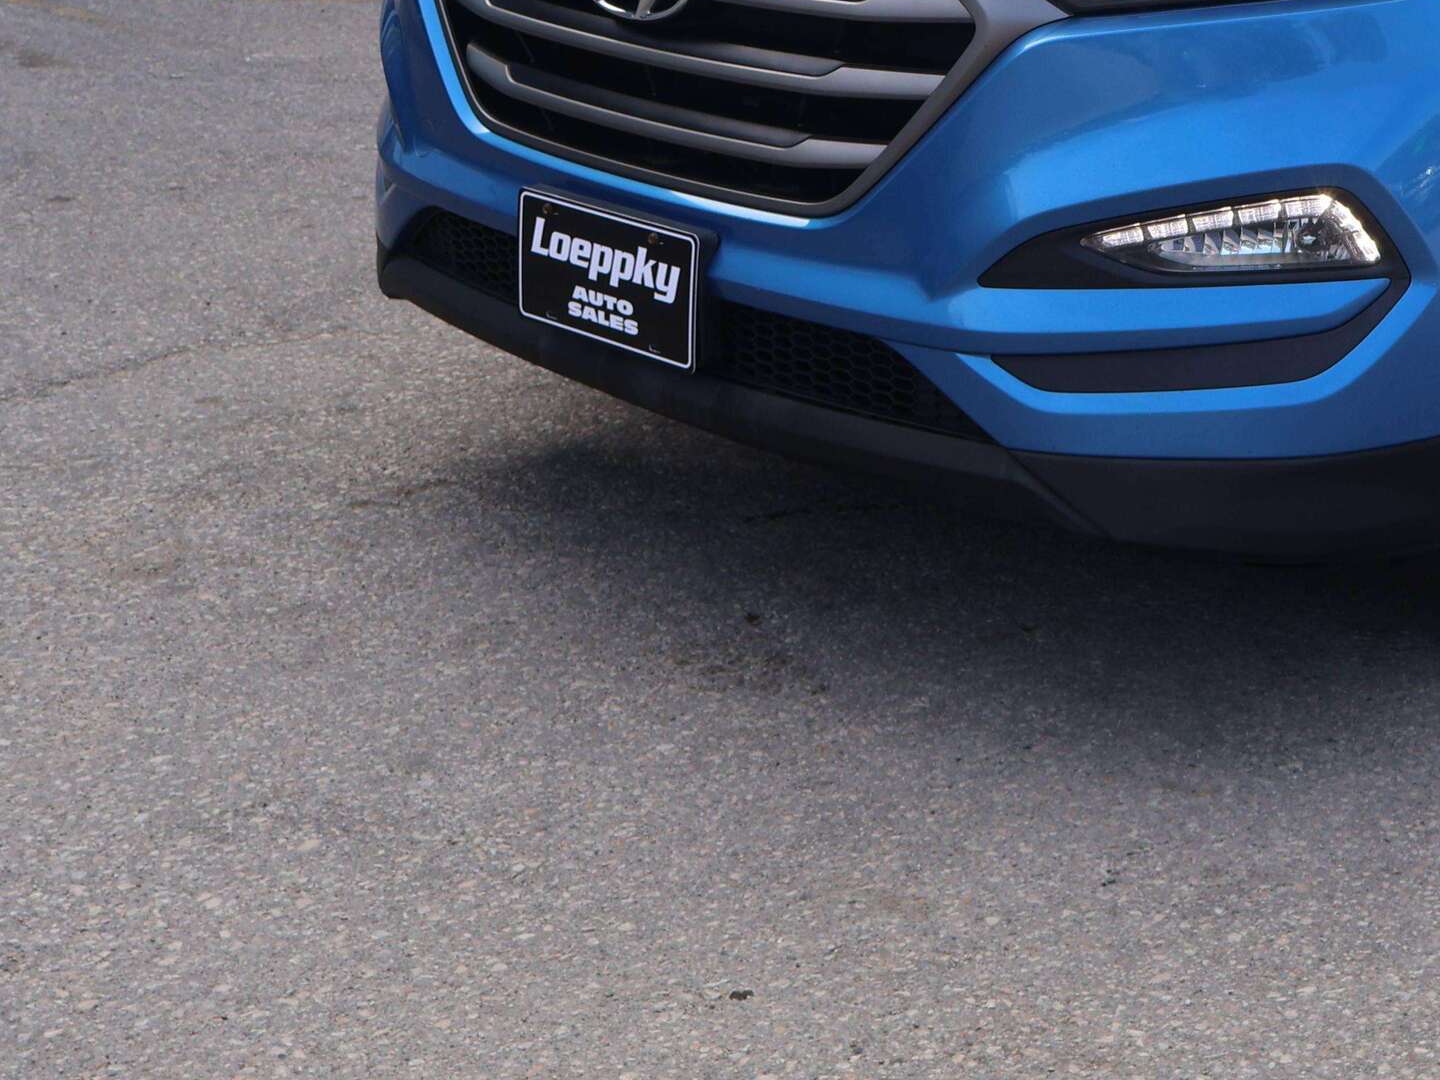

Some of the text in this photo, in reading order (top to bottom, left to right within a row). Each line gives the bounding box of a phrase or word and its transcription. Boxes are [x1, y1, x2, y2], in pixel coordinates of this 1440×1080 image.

[530, 216, 680, 304] Loeppky
[572, 285, 634, 316] AUTO
[567, 301, 639, 336] SALES
